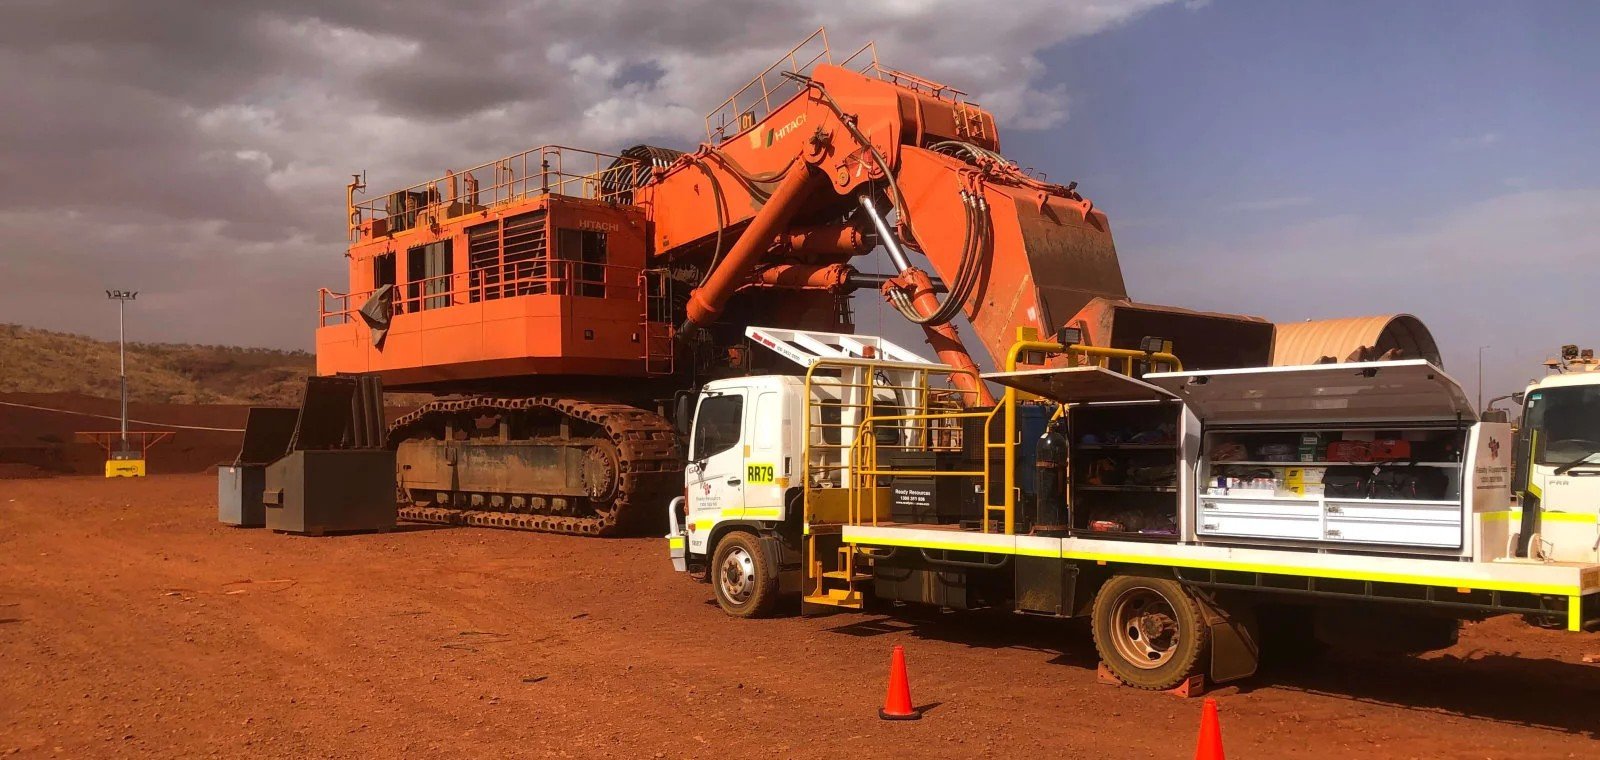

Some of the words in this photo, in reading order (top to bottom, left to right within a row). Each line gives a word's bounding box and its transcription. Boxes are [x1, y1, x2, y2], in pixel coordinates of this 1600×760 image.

[742, 113, 752, 130] 01
[579, 219, 619, 232] HITACHI
[747, 465, 774, 482] RR79
